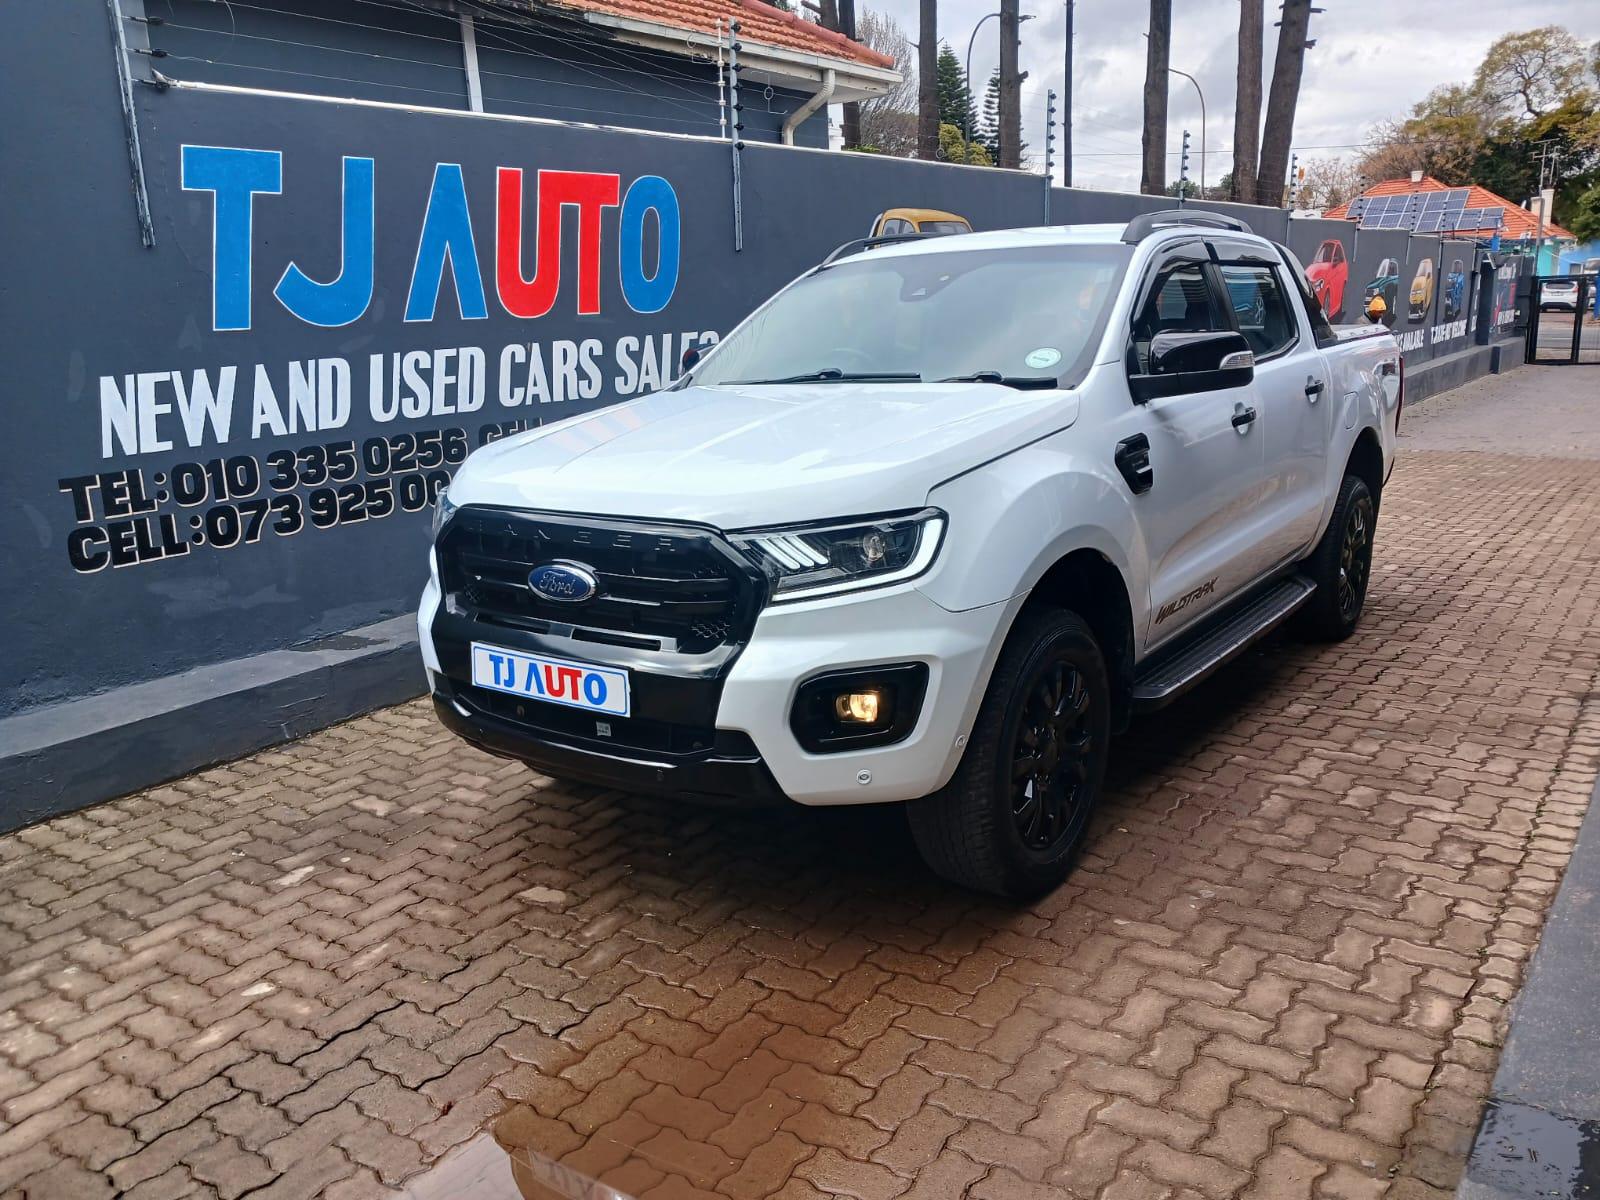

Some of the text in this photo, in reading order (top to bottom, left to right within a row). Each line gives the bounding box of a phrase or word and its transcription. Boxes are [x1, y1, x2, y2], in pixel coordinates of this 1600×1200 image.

[180, 144, 681, 331] TJ AUTO
[99, 330, 720, 459] NEW AND USED CARS SALE
[266, 440, 358, 492] 335
[362, 427, 469, 476] 0256
[309, 477, 395, 530] 925
[538, 569, 577, 597] Ford
[1154, 575, 1220, 625] WILDTRAK
[488, 653, 608, 705] TJ AUTO
